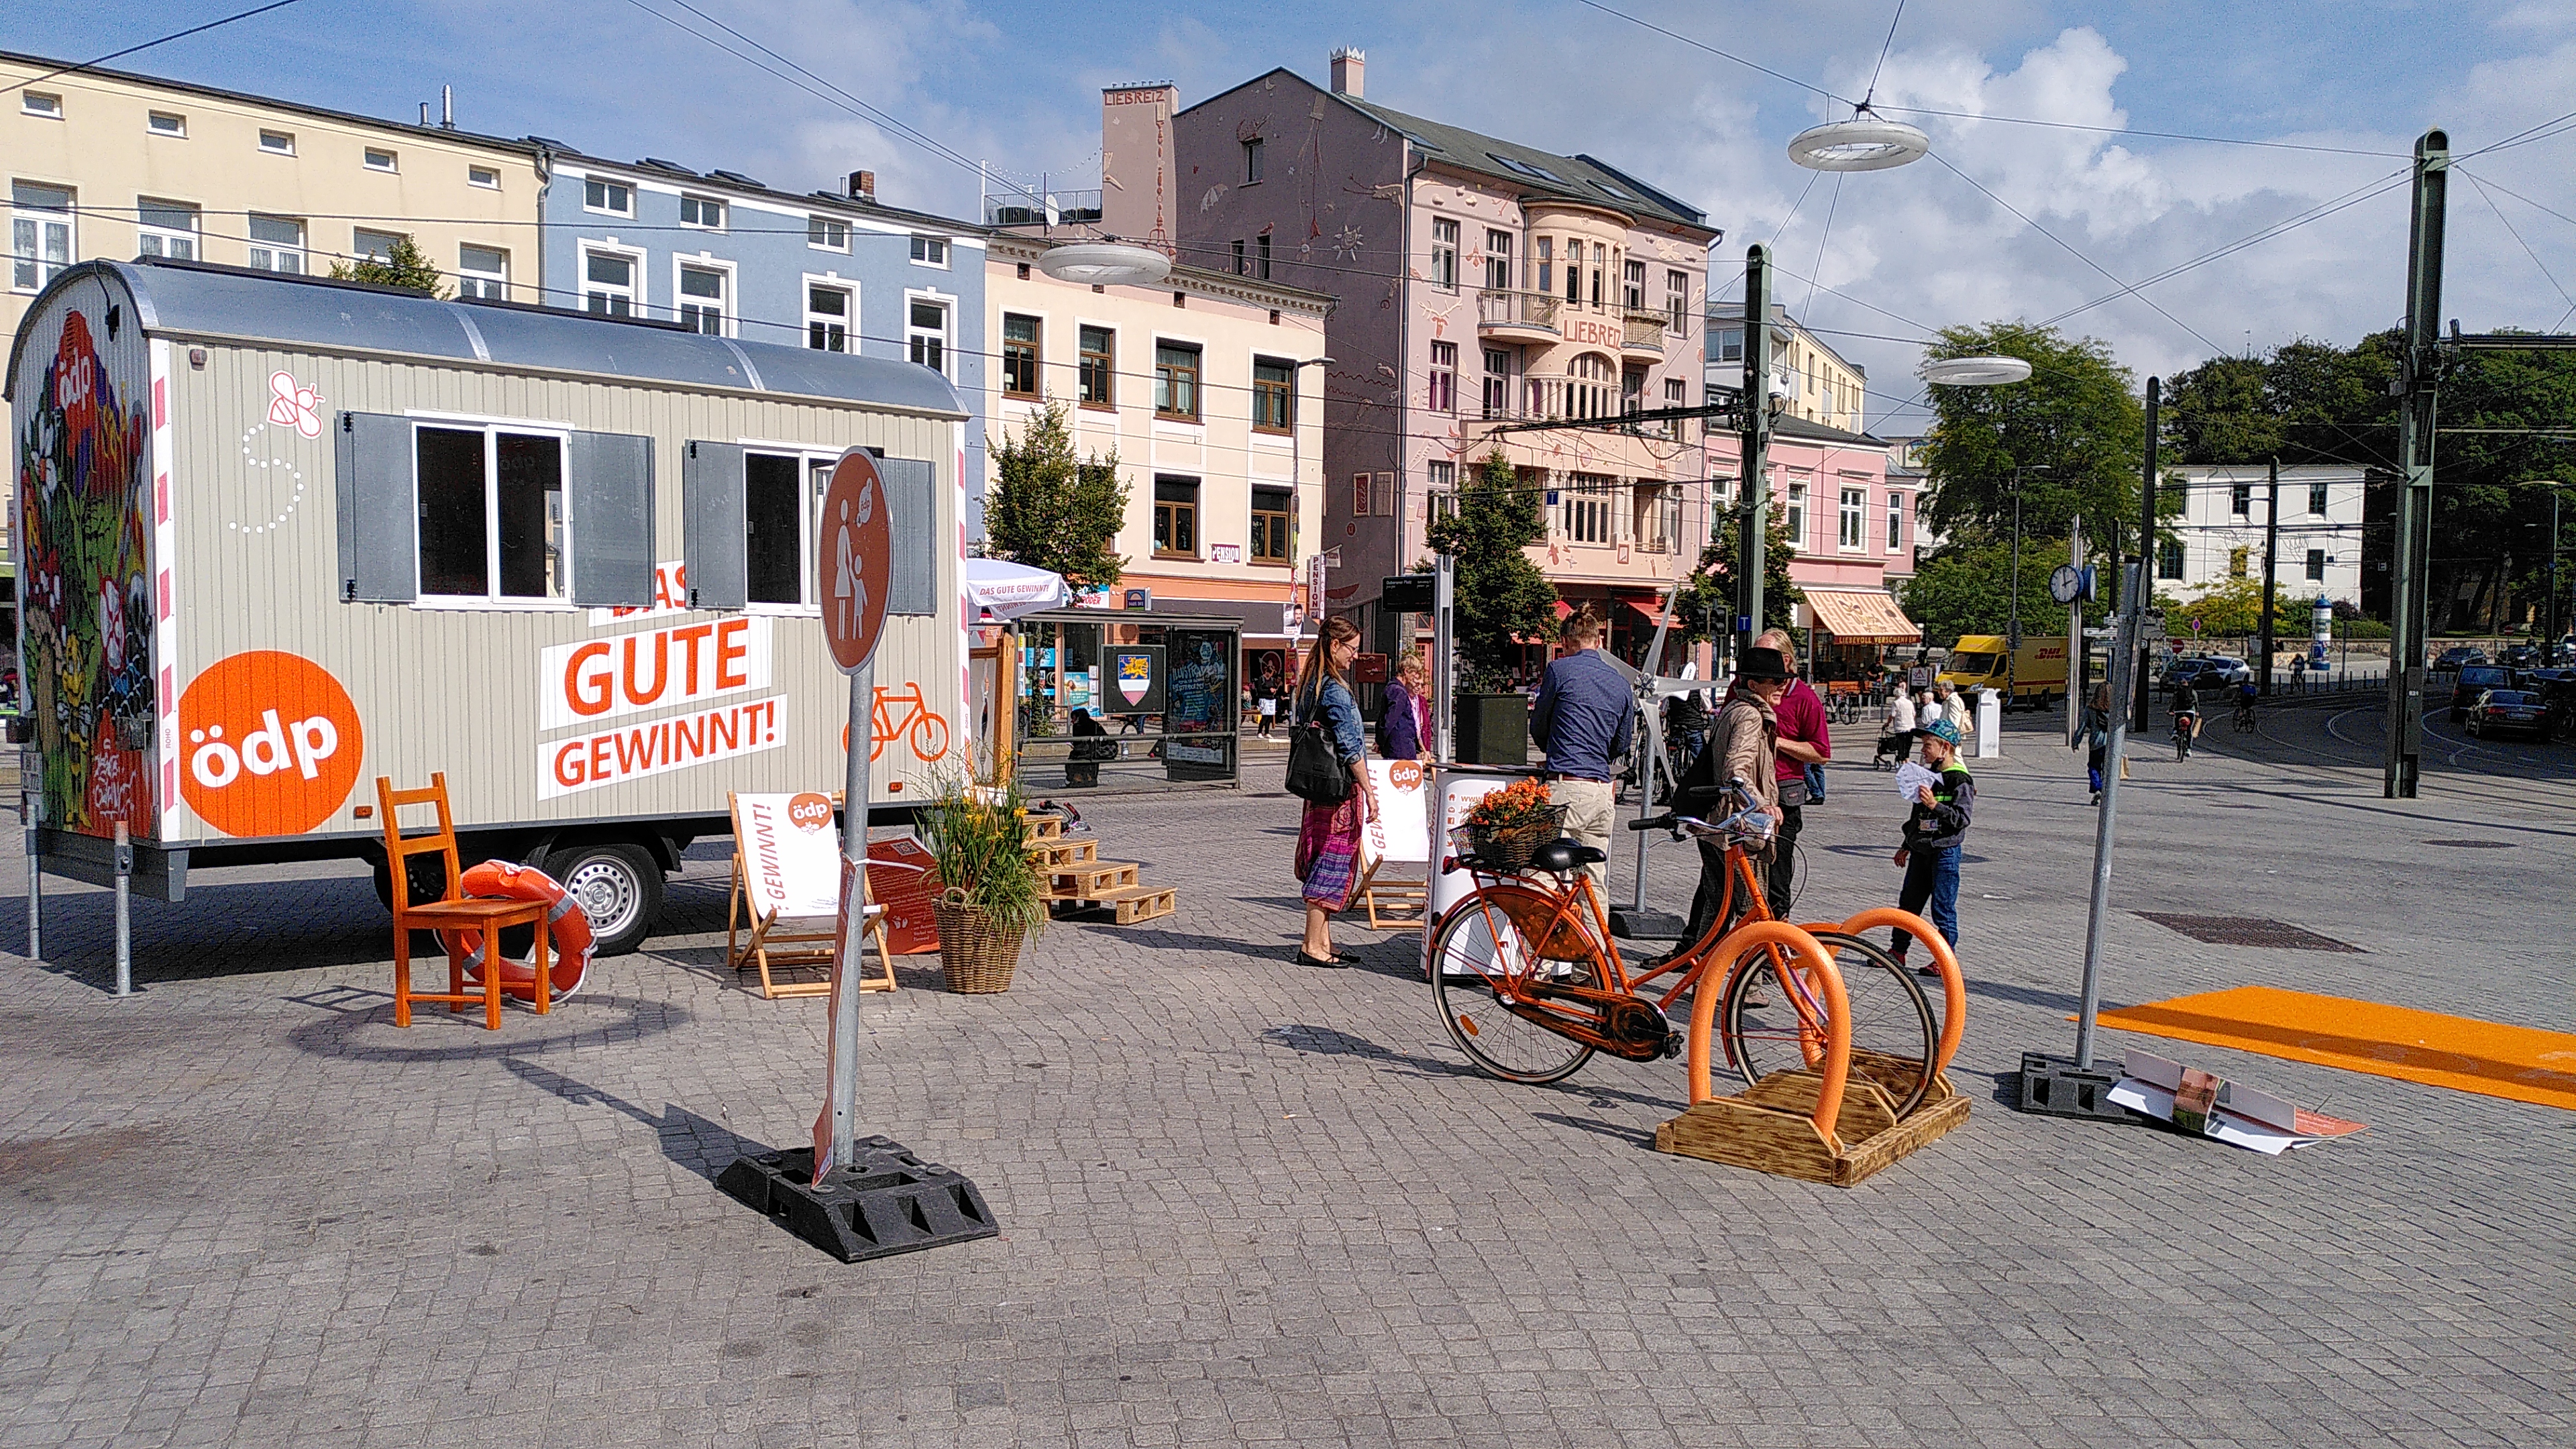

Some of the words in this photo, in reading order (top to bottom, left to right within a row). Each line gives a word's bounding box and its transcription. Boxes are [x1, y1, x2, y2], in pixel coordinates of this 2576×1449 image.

[1104, 91, 1165, 106] LIEBREIZ
[1564, 319, 1621, 351] LIEBREIZ
[60, 347, 91, 411] ödp
[861, 498, 871, 512] ödp
[1549, 492, 1556, 504] T
[1212, 546, 1239, 560] PENSION
[979, 588, 995, 596] DAS
[997, 585, 1015, 595] GUTE
[1016, 584, 1049, 593] GEWINNT!
[1740, 616, 1749, 630] T
[564, 618, 749, 716] GUTE
[190, 708, 337, 788] ödp
[554, 700, 774, 788] GEWINNT!
[1393, 767, 1419, 782] ödp
[793, 801, 828, 819] ödp
[753, 803, 786, 900] GEWINNT!
